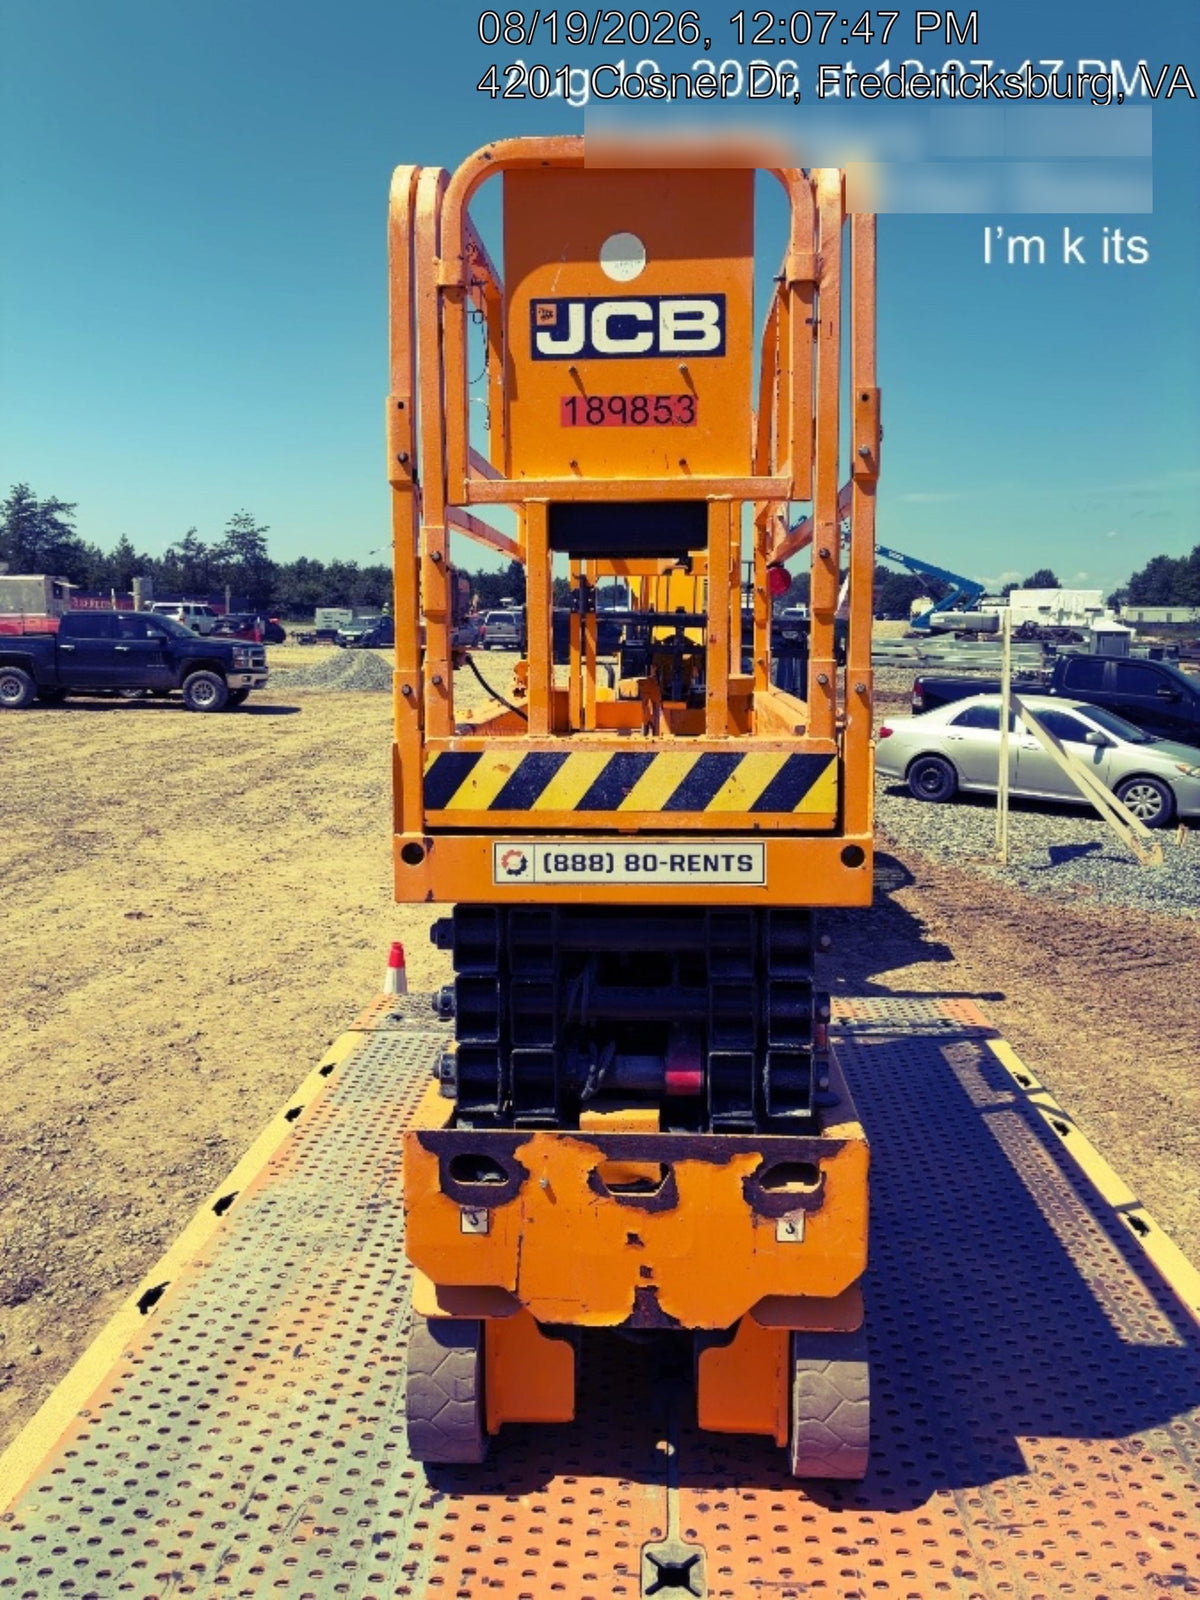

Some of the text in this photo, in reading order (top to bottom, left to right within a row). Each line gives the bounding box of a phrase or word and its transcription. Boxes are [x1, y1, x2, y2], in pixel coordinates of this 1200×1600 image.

[536, 300, 721, 355] JCB
[565, 395, 696, 426] 189853
[543, 853, 753, 873] (888) 80-RENTS
